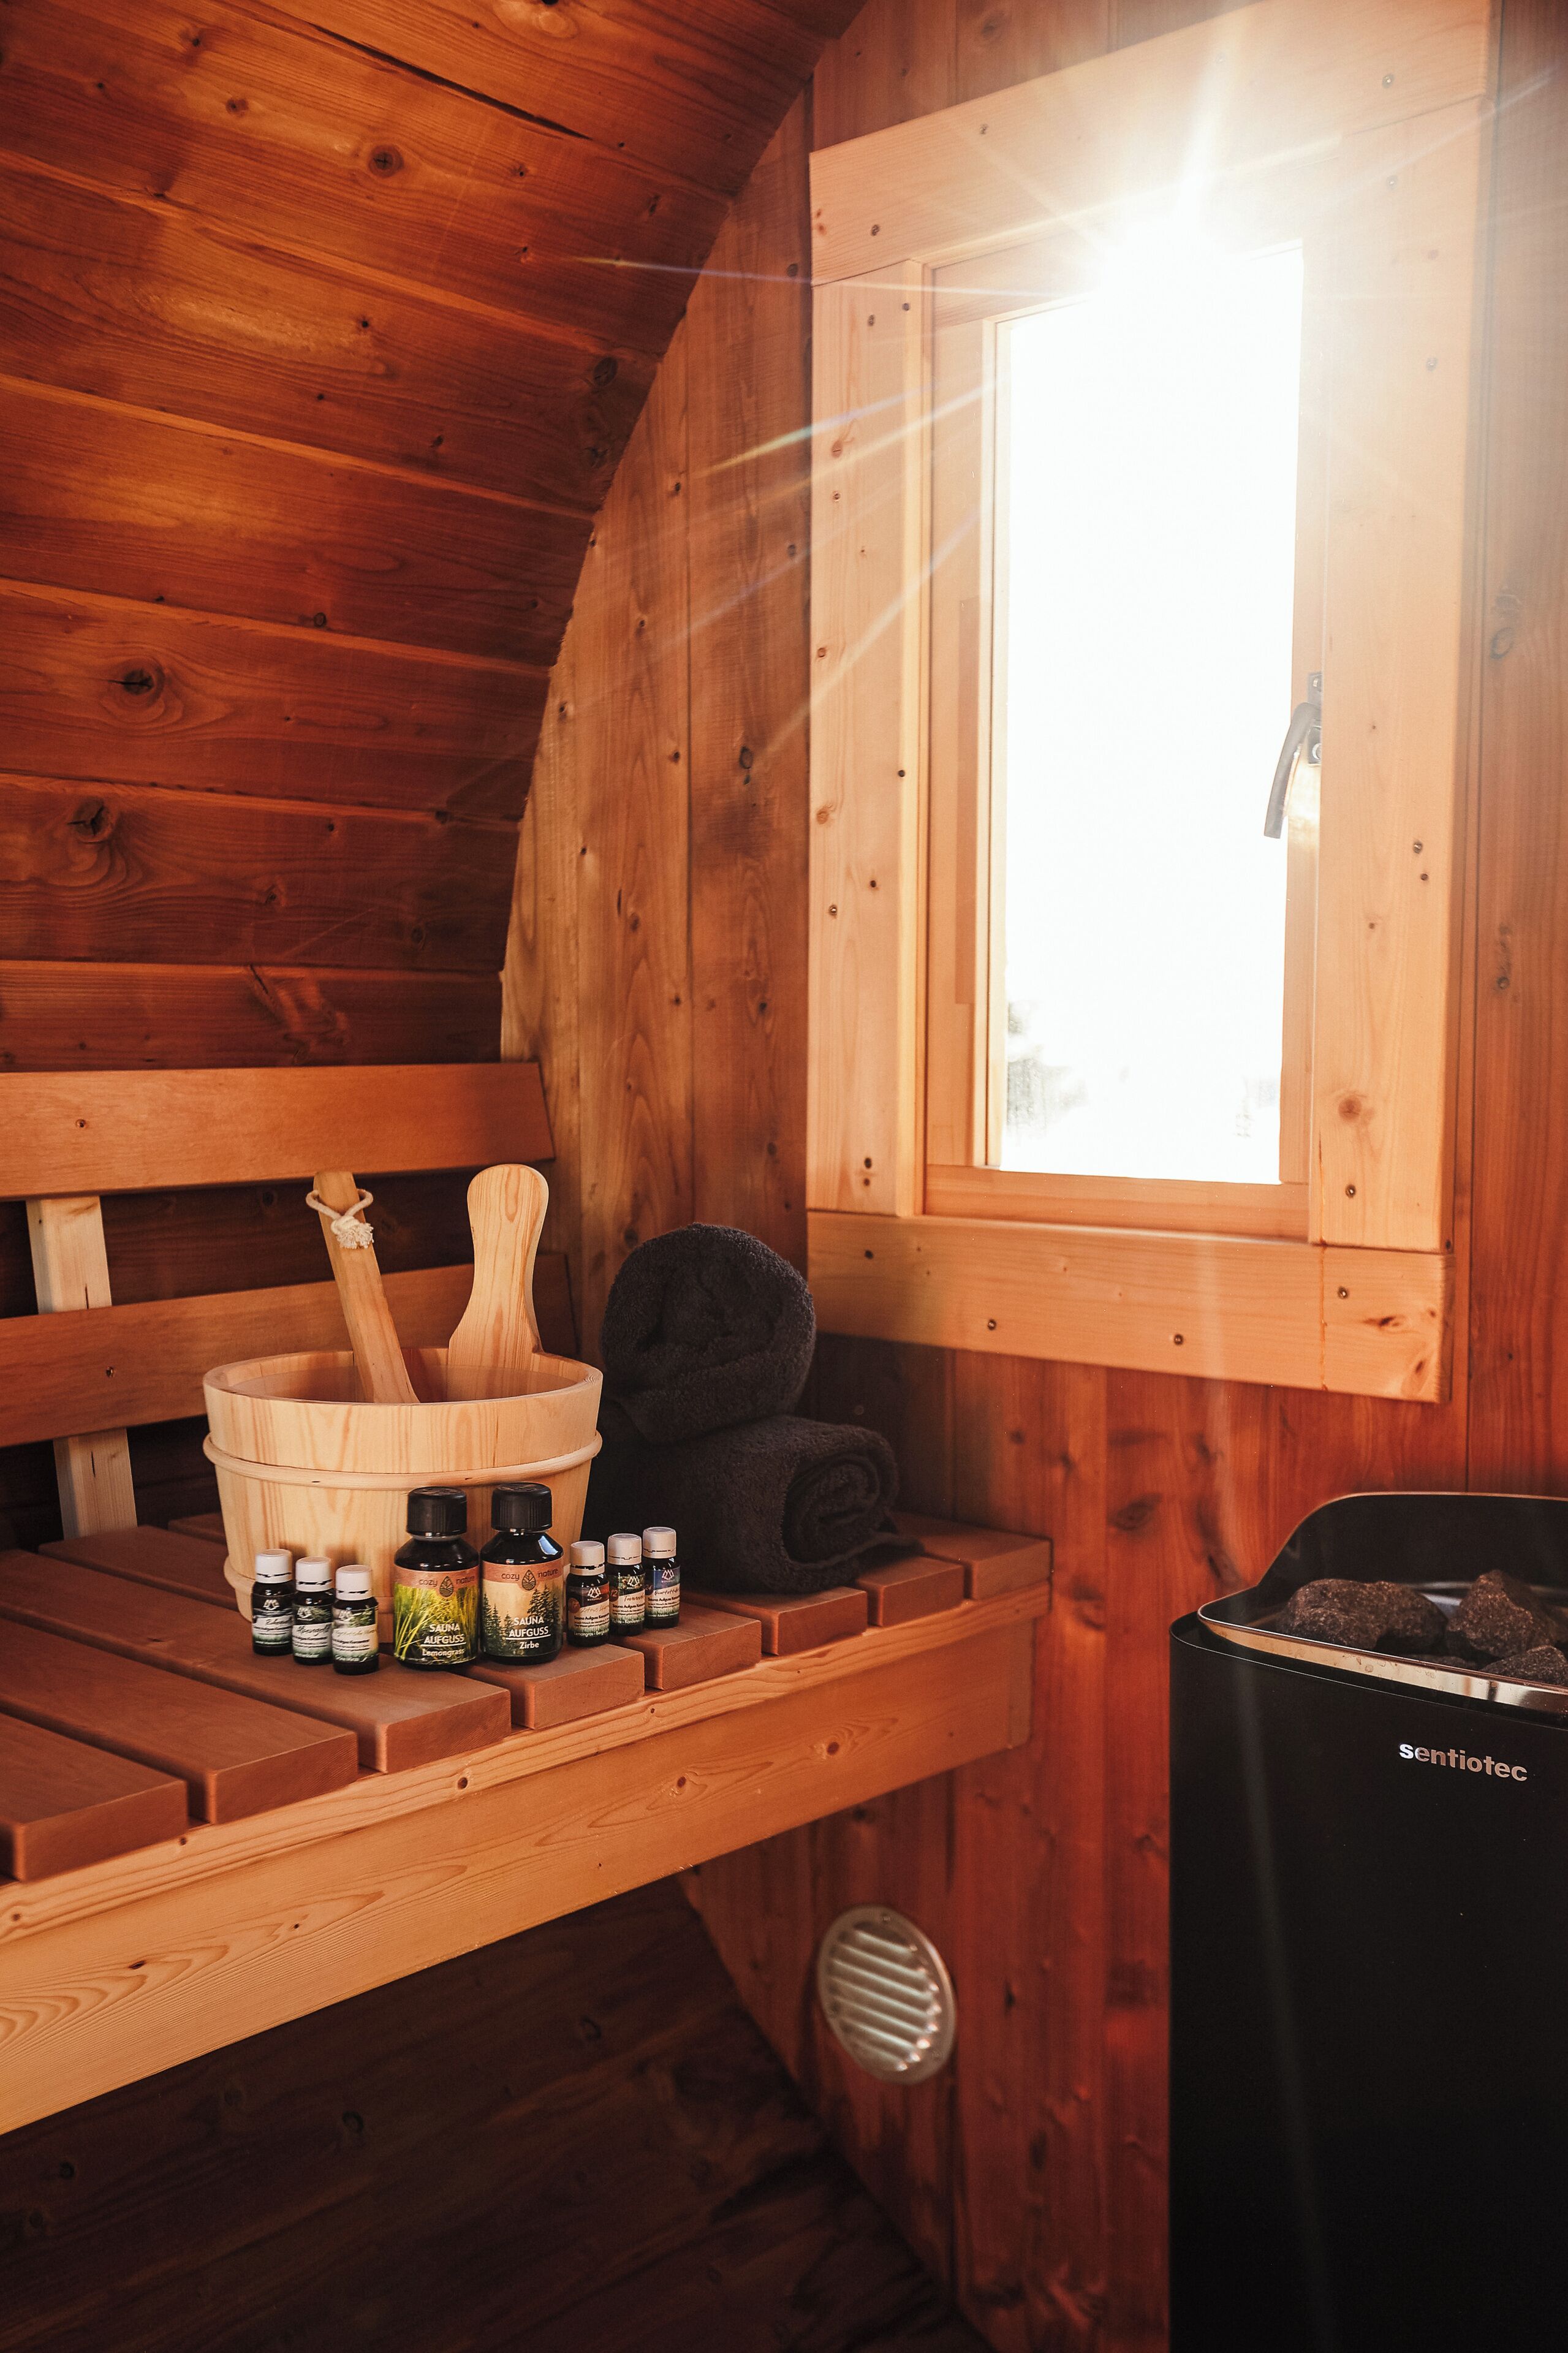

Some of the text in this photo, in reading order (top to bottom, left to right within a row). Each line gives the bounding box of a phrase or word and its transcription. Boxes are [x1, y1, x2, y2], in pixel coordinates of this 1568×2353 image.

[501, 1567, 559, 1582] cozy nature
[419, 1575, 475, 1588] cozy nature
[512, 1616, 545, 1626] SAUNA
[429, 1622, 460, 1632] SAUNA
[508, 1626, 550, 1638] AUFGUSS
[423, 1634, 466, 1645] AUFGUSS
[518, 1640, 540, 1650] Zirbe
[422, 1648, 466, 1658] Lemongrass
[1399, 1743, 1528, 1782] sentiotec
